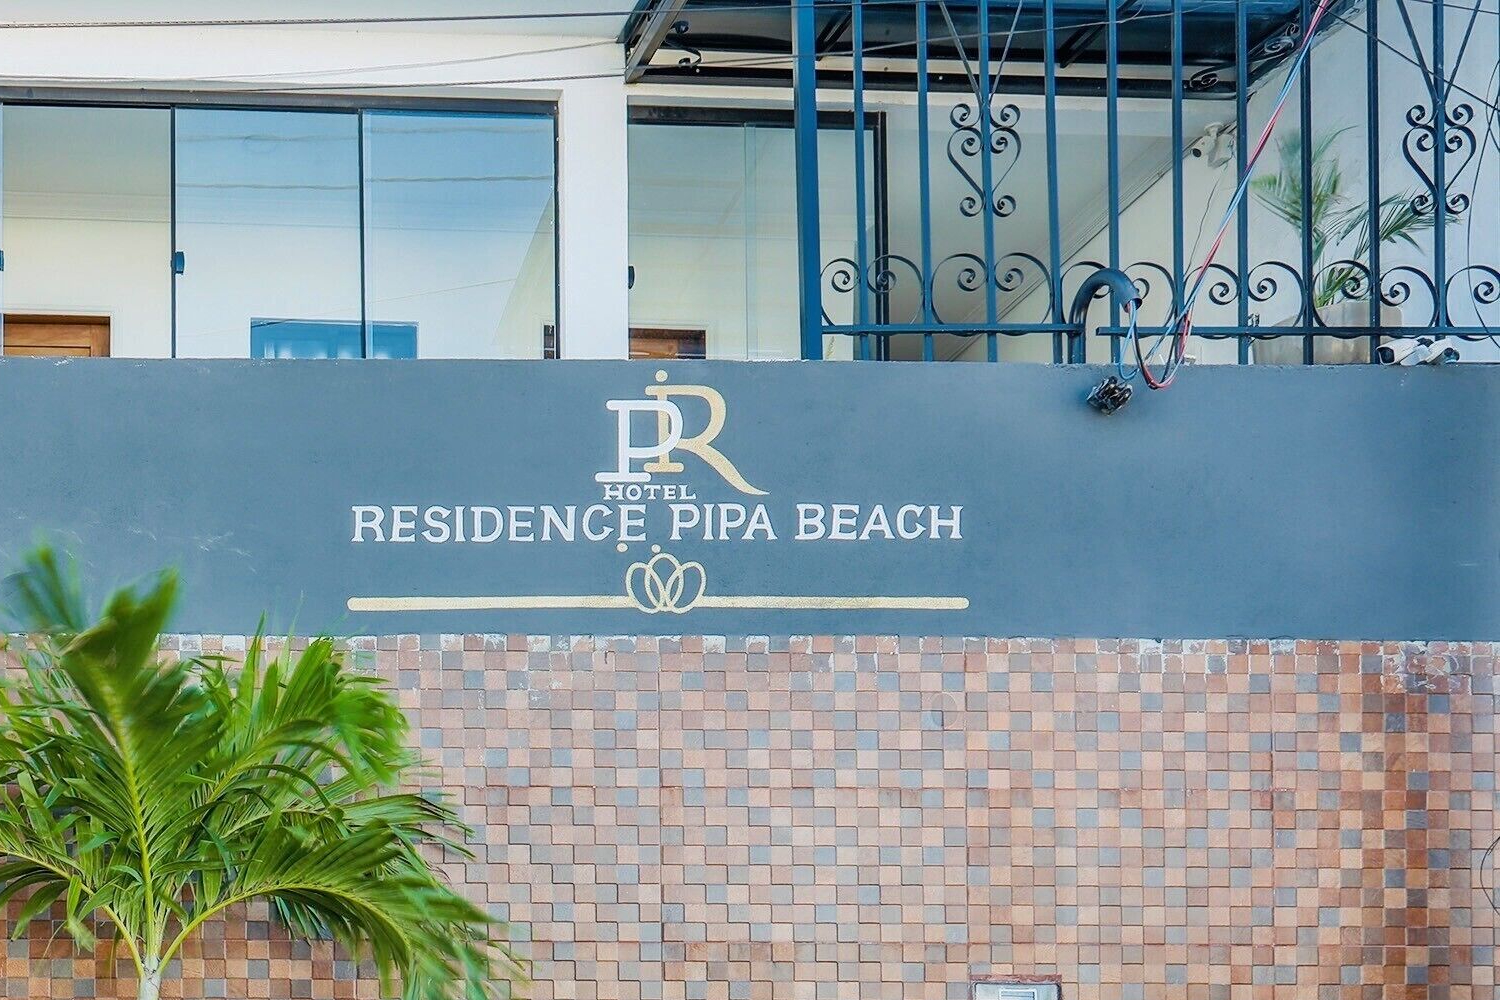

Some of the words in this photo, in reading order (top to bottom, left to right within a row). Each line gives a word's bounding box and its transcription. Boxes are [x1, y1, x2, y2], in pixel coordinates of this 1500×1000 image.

[603, 484, 697, 501] HOTEL
[351, 504, 647, 543] RESIDENCE
[668, 503, 778, 541] PIPA
[794, 503, 964, 541] BEACH
